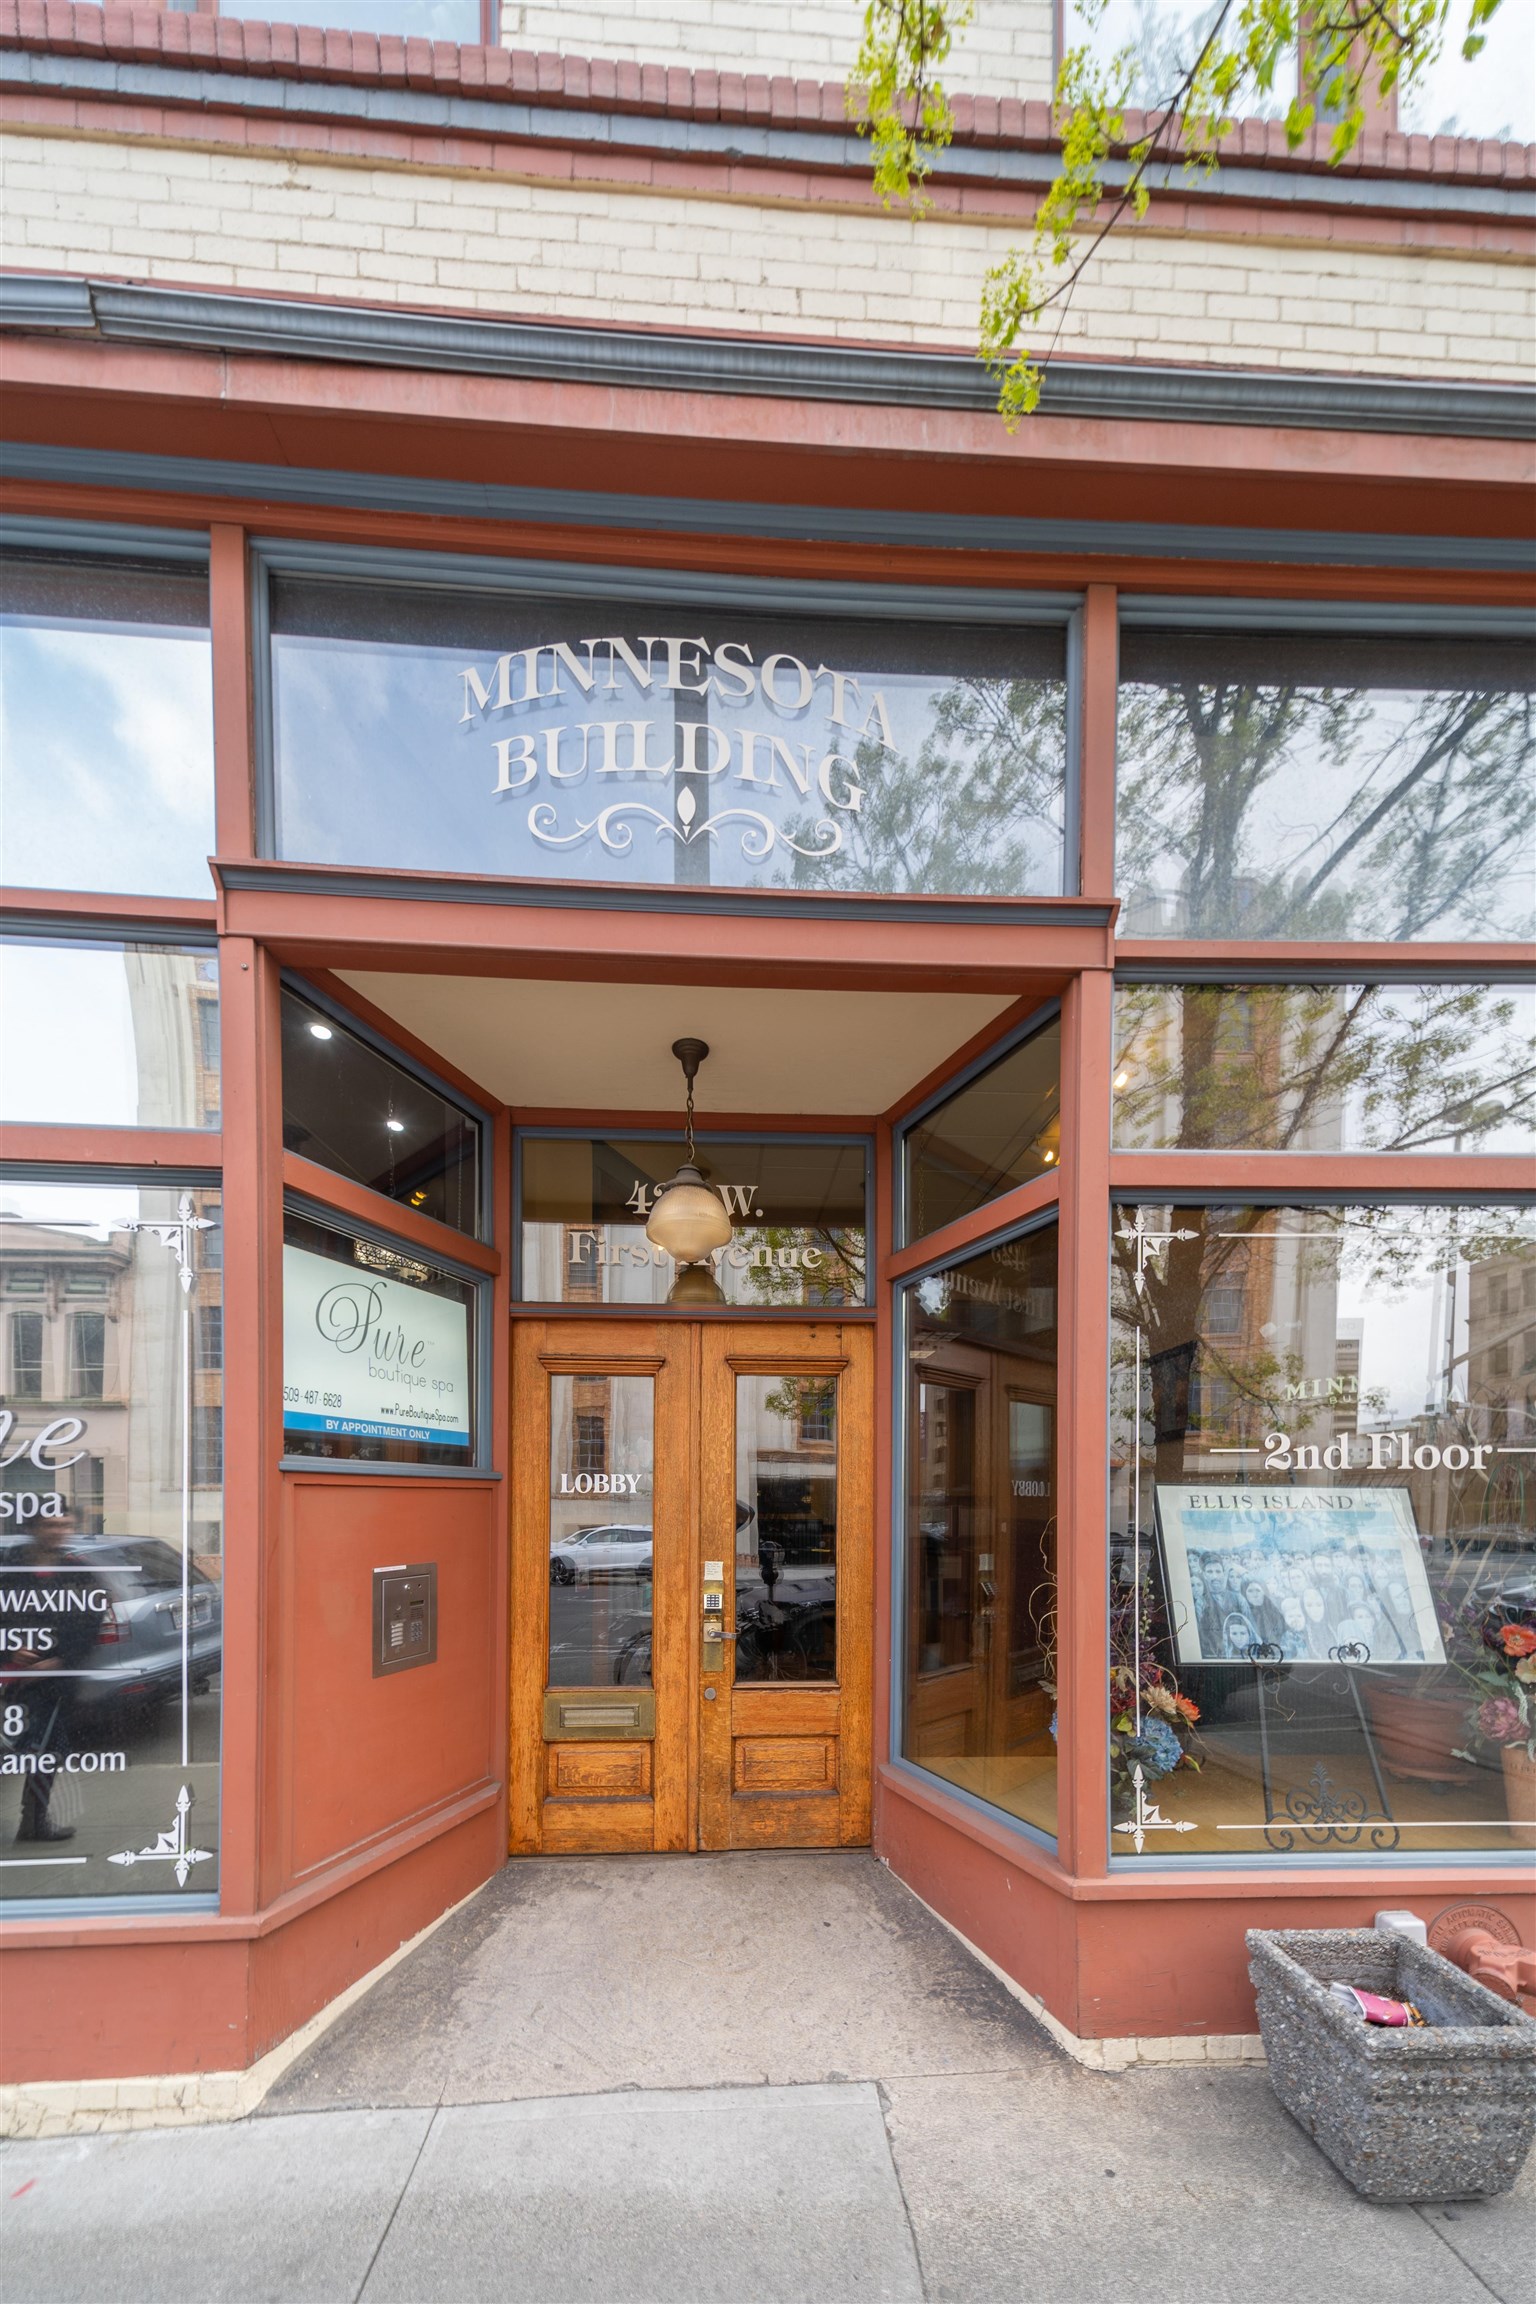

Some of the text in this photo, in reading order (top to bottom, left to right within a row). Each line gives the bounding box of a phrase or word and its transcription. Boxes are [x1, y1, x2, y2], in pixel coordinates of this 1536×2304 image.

[457, 636, 899, 753] MINNESOTA
[491, 721, 866, 812] BUILDING
[716, 1185, 763, 1217] W.
[568, 1230, 668, 1267] First
[316, 1282, 427, 1368] Pure
[368, 1357, 454, 1398] boutique spa
[326, 1419, 430, 1440] BY APPOINTMENT ONLY
[380, 1402, 459, 1426] www.PureBoutiqueSpa.com
[1264, 1430, 1493, 1470] 2nd Floor
[560, 1473, 642, 1494] LOBBY
[0, 1491, 64, 1525] spa
[1189, 1494, 1353, 1510] ELLIS ISLAND
[0, 1589, 107, 1612] WAXING
[3, 1704, 24, 1736] 8
[0, 1751, 126, 1775] ane.com
